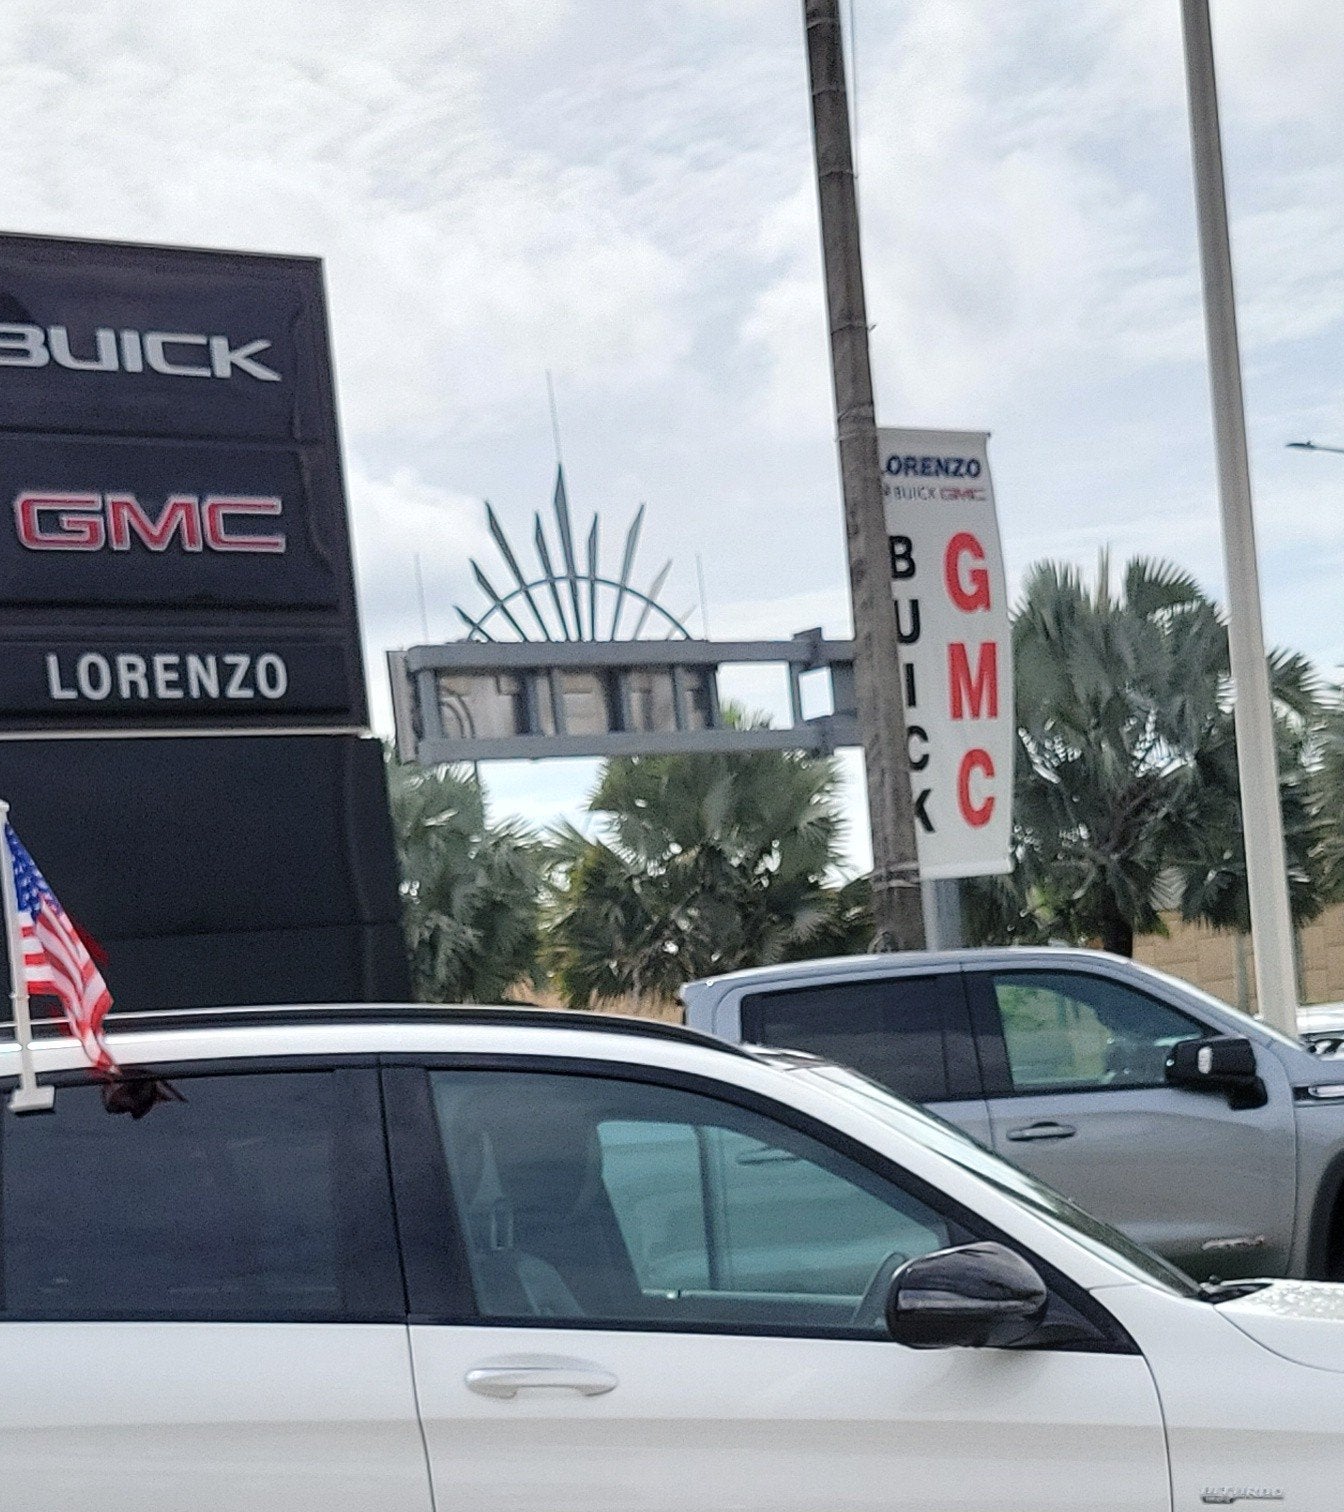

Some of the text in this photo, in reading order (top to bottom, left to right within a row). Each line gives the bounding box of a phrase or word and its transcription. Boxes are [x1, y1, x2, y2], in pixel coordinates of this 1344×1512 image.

[883, 455, 981, 478] ORENZO
[13, 490, 287, 553] GMC
[45, 652, 289, 700] LORENZO
[943, 531, 998, 829] GMC
